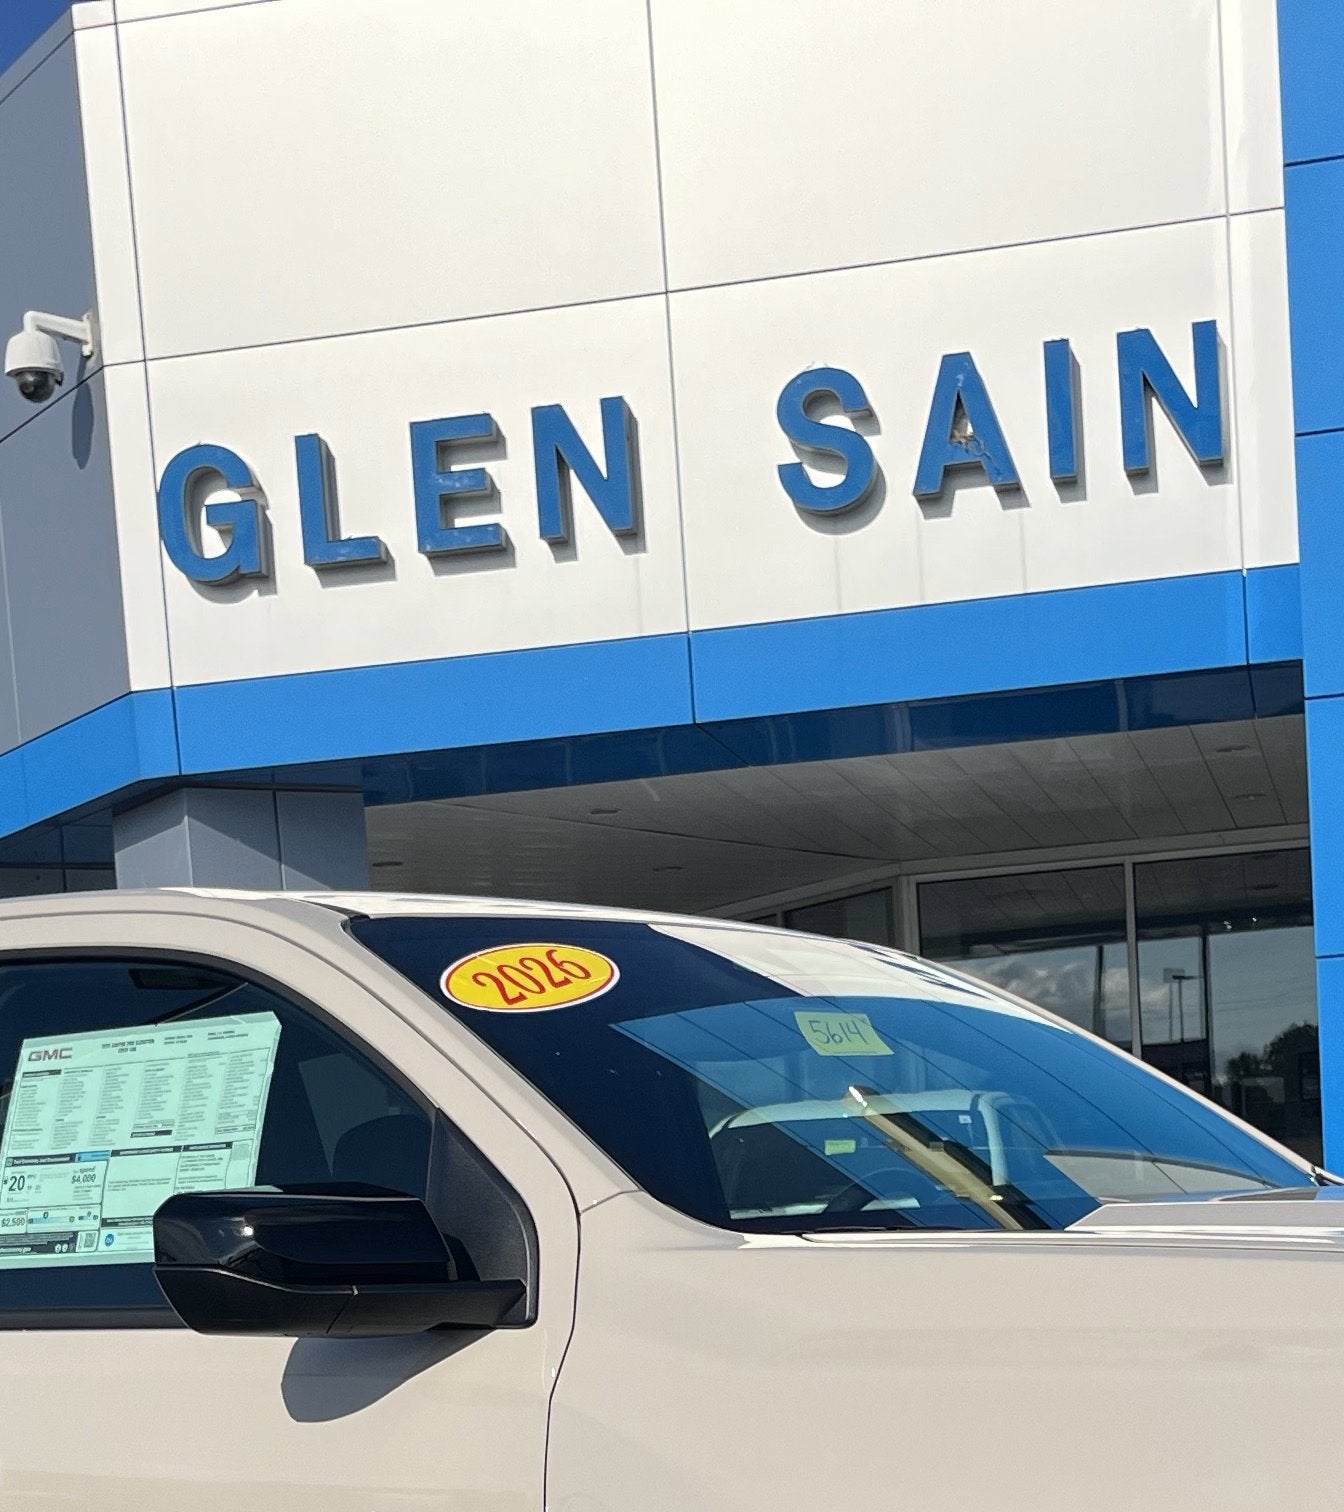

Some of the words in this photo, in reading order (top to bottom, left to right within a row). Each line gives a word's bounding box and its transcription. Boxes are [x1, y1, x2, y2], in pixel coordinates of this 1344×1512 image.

[157, 395, 639, 586] GLEN
[775, 319, 1225, 514] SAIN
[471, 949, 591, 1006] 2026
[808, 1019, 870, 1045] 5614
[27, 1047, 73, 1062] GMC
[8, 1175, 26, 1192] 20
